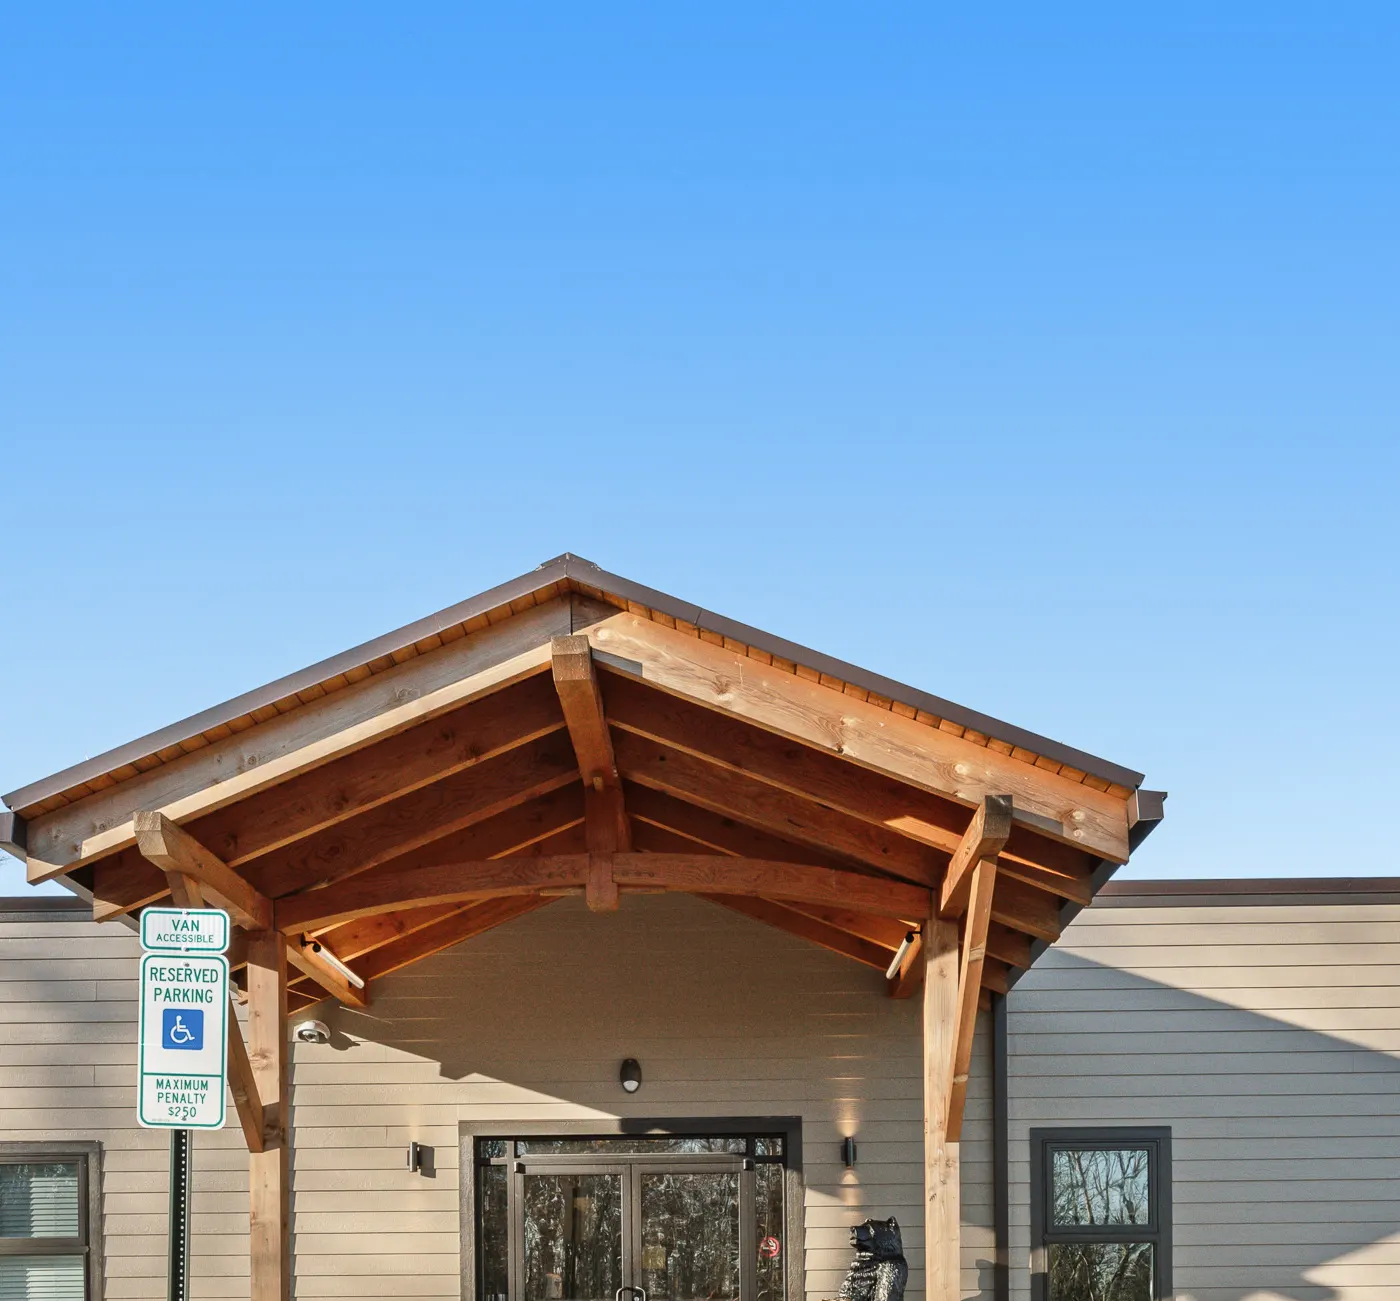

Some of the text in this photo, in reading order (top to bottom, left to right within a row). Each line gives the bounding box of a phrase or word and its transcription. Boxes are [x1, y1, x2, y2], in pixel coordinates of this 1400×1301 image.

[172, 919, 200, 932] VAN
[156, 933, 214, 943] ACCESSIBLE
[150, 967, 219, 983] RESERVED
[154, 988, 213, 1003] PARKING
[156, 1078, 209, 1091] MAXIMUM
[157, 1092, 207, 1105] PENALTY
[168, 1106, 197, 1118] $250
